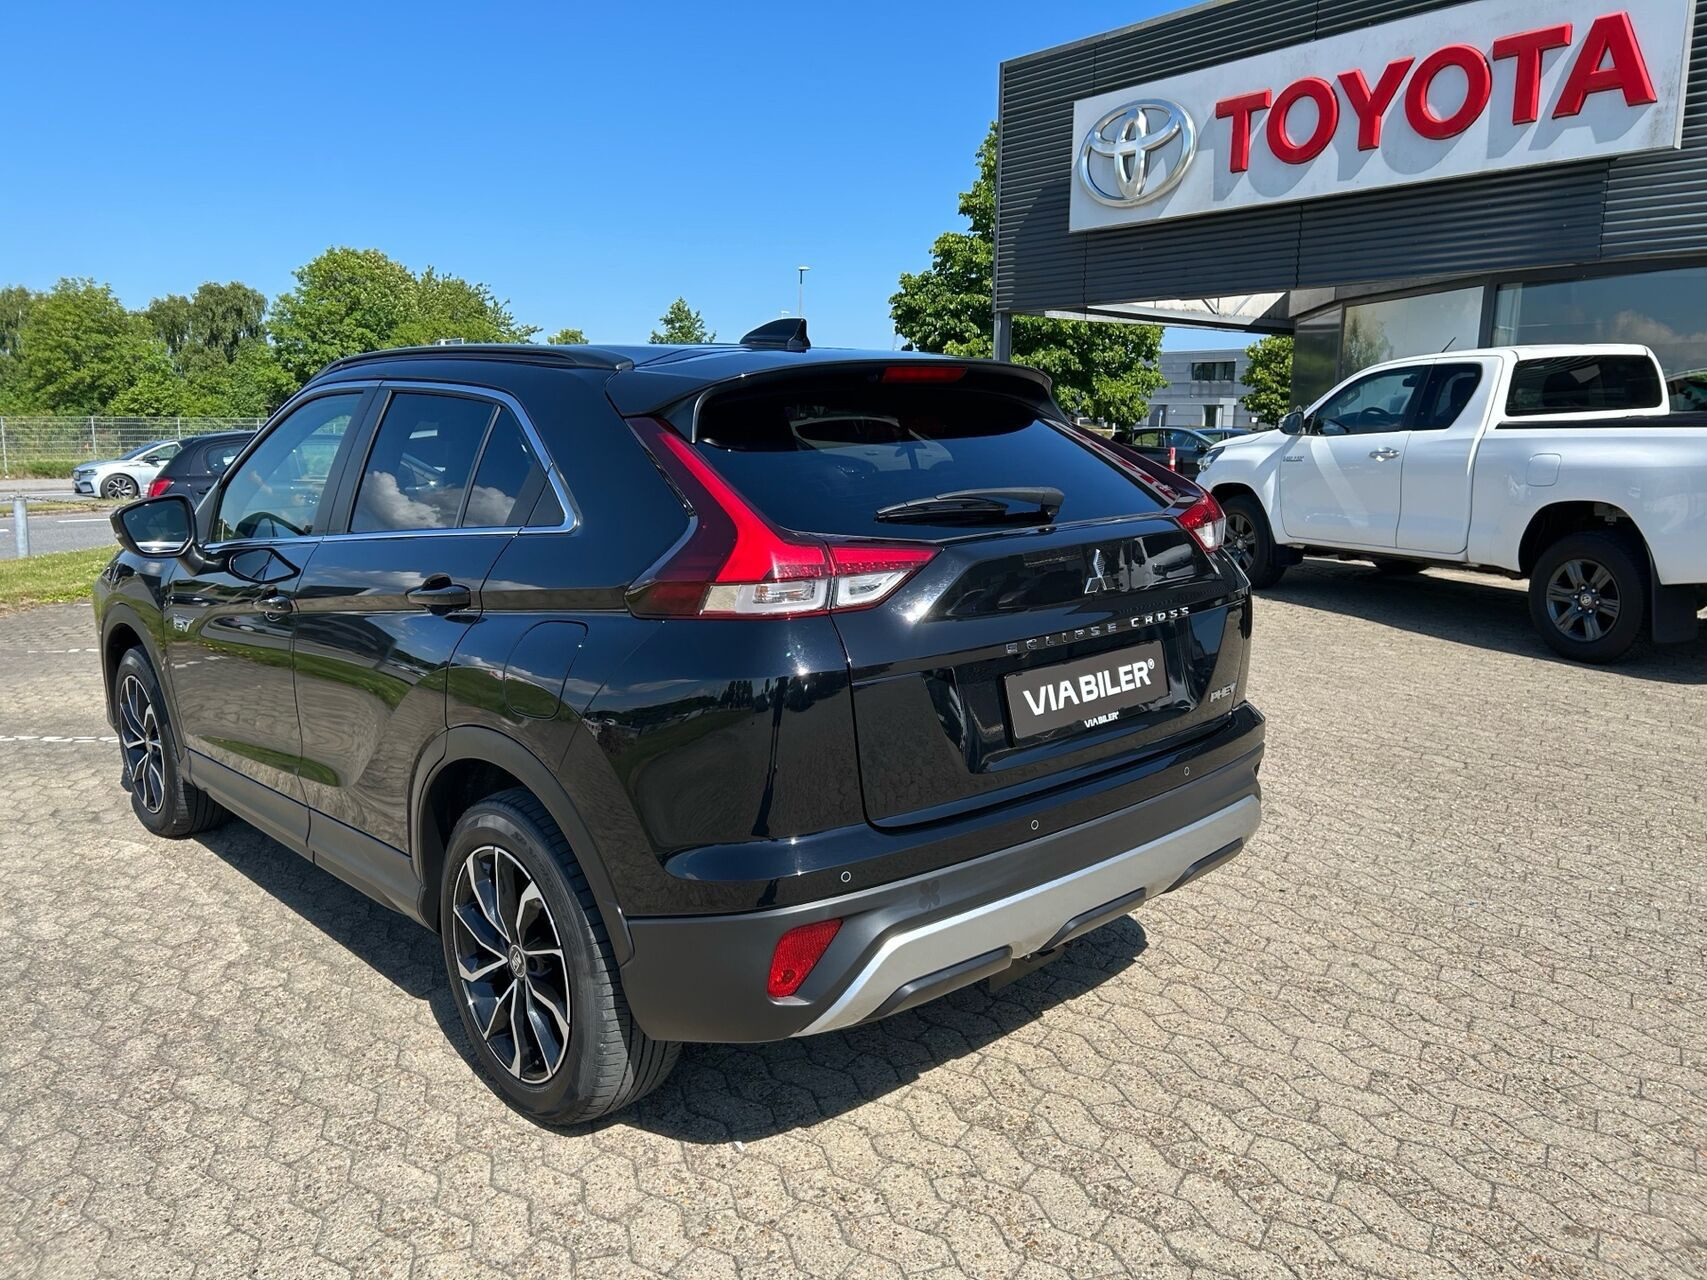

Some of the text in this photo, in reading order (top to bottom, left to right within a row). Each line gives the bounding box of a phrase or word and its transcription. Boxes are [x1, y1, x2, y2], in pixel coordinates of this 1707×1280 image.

[1215, 11, 1657, 173] TOYOTA
[1006, 607, 1189, 653] ECLIPSE CROSS
[1210, 682, 1236, 702] PHEV
